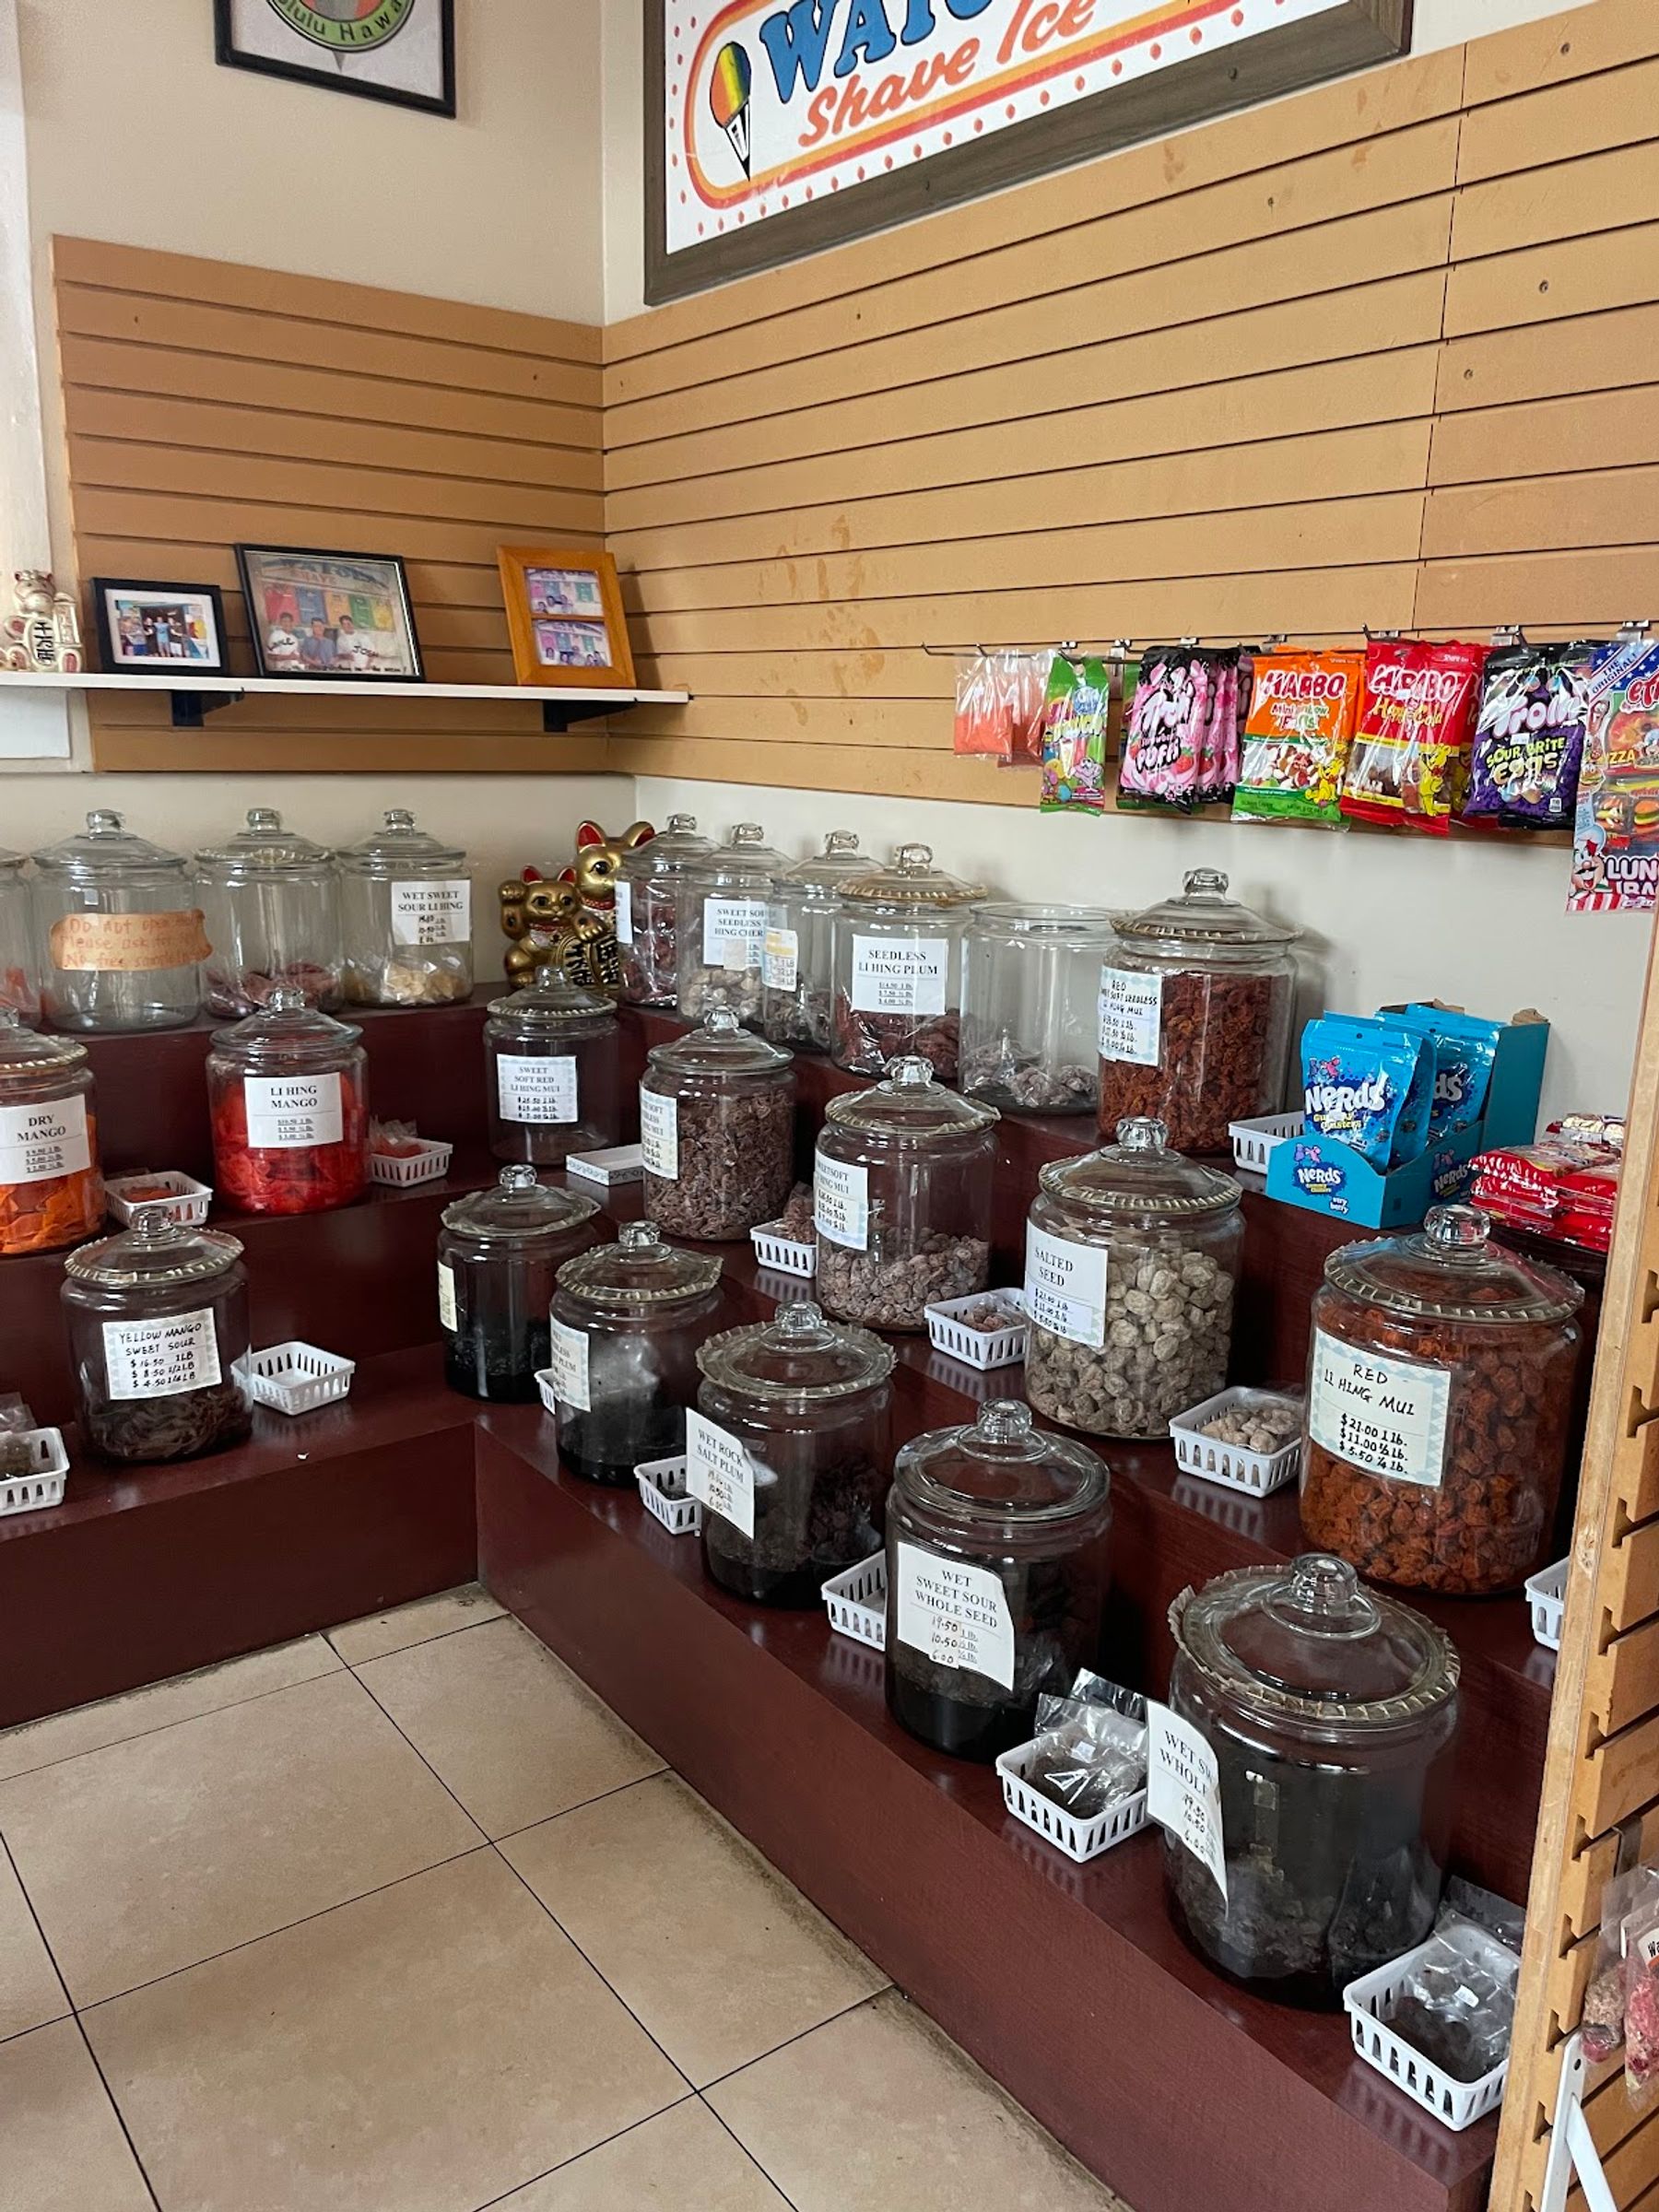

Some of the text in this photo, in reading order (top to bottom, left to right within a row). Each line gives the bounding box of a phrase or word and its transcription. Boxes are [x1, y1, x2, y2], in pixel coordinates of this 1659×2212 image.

[798, 0, 1097, 147] Shave Ice
[1603, 660, 1620, 677] THE
[1264, 670, 1347, 700] HARIBO
[1485, 746, 1523, 769] SOUR
[402, 890, 460, 900] WET SWEET
[398, 903, 426, 912] SOUR
[439, 901, 464, 912] HING
[717, 908, 747, 917] SWEET
[69, 918, 92, 934] Do
[718, 918, 762, 927] SEEDLESS
[868, 949, 927, 961] SEEDLESS
[858, 962, 938, 975] LI HING PLUM
[271, 1085, 318, 1097] LI HING
[271, 1097, 318, 1109] MANGO
[29, 1114, 55, 1127] DRY
[18, 1125, 66, 1142] MANGO
[1035, 1246, 1074, 1273] SALTED
[1039, 1266, 1065, 1288] SEED
[119, 1323, 202, 1345] YELLOW MANGO
[125, 1336, 195, 1357] SWEET SOUR
[1353, 1363, 1388, 1385] RED
[1324, 1369, 1416, 1417] LI HING MUI
[1341, 1413, 1379, 1439] $21.00
[698, 1429, 745, 1468] WET ROCK
[1339, 1428, 1377, 1453] $11.00
[697, 1444, 745, 1484] SALT PLUM
[941, 1570, 973, 1587] WET
[916, 1575, 998, 1613] SWEET SOUR
[914, 1589, 998, 1629] WHOLE SEED
[932, 1615, 959, 1633] 19.50
[931, 1631, 959, 1648] 10.50
[932, 1650, 955, 1665] 6.00
[1164, 1730, 1195, 1765] WET
